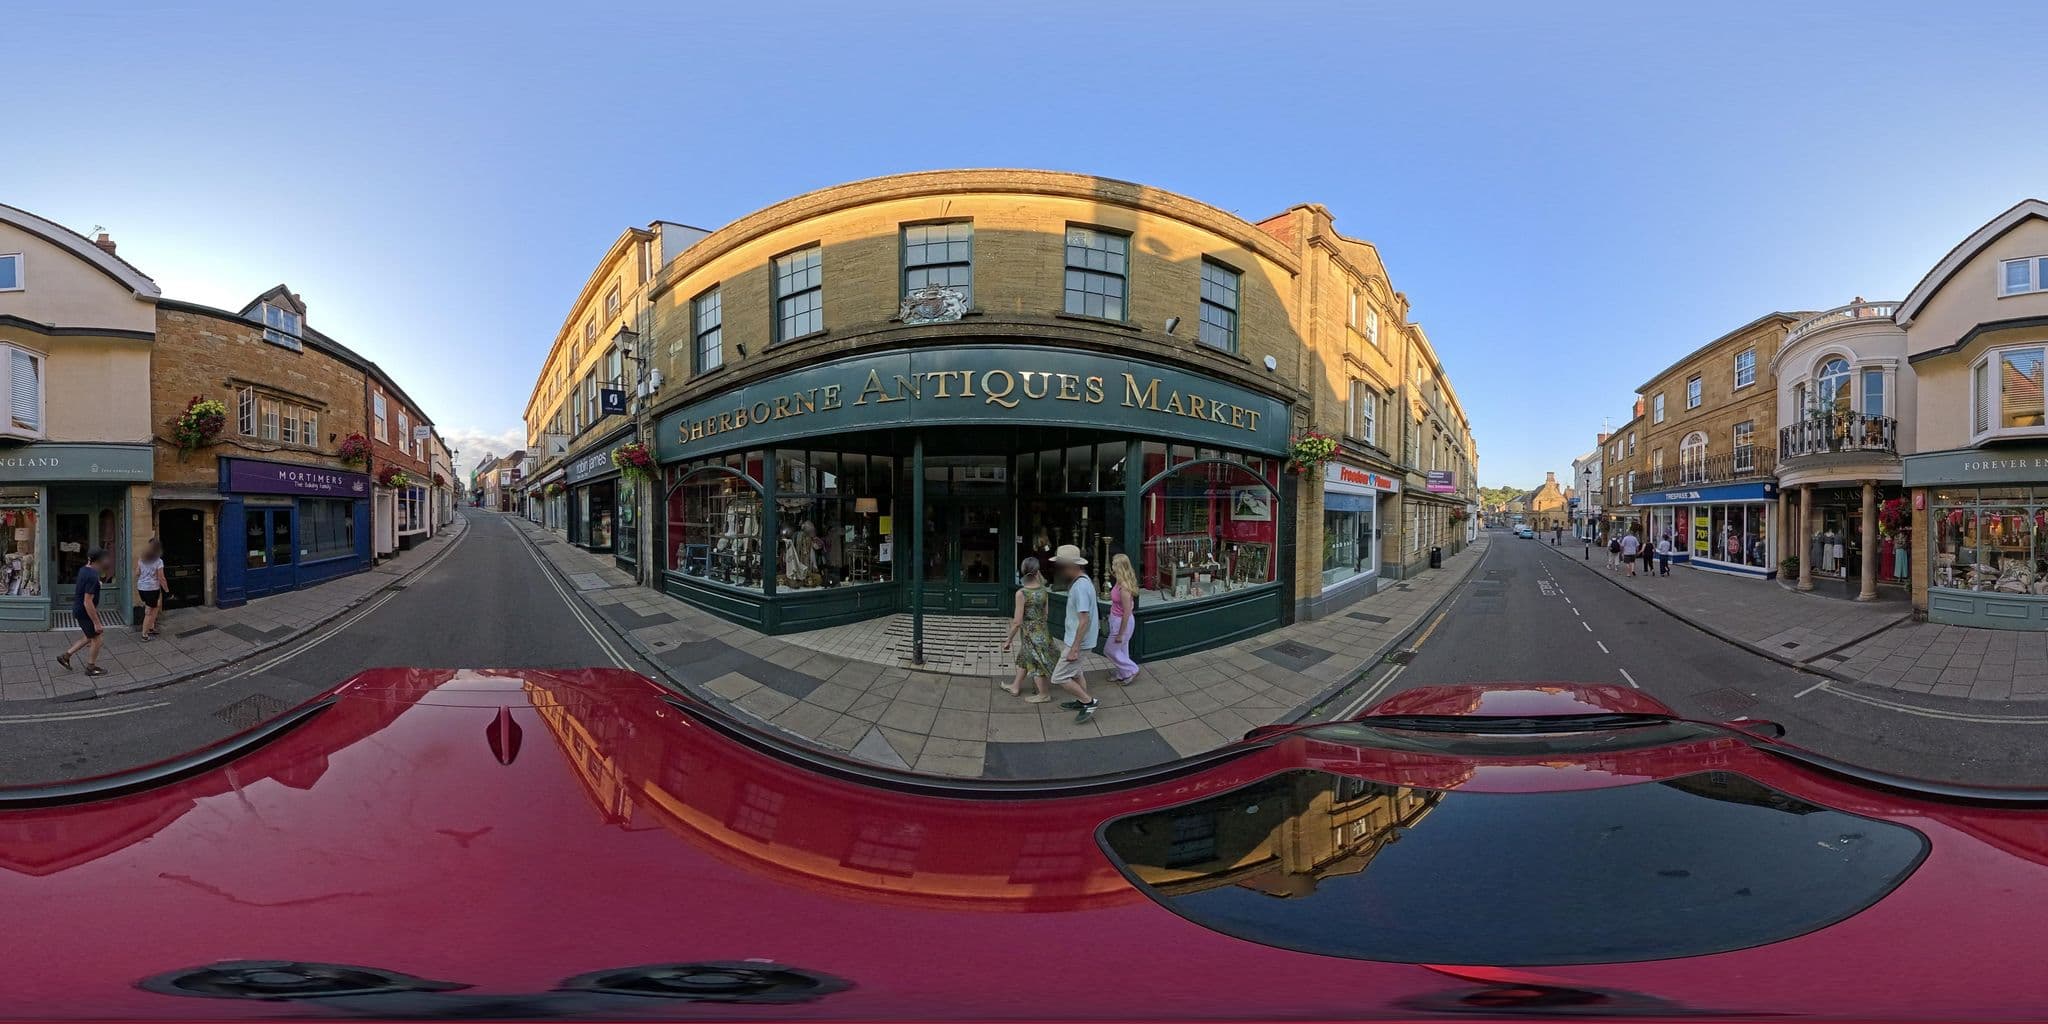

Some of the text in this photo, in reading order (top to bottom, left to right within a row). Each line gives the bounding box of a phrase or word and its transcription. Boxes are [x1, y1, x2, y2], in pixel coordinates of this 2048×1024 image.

[677, 368, 1261, 445] SHERBORNE ANTIQUES MARKET
[1964, 460, 2027, 471] FOREVER
[279, 471, 343, 485] MORTIMERS
